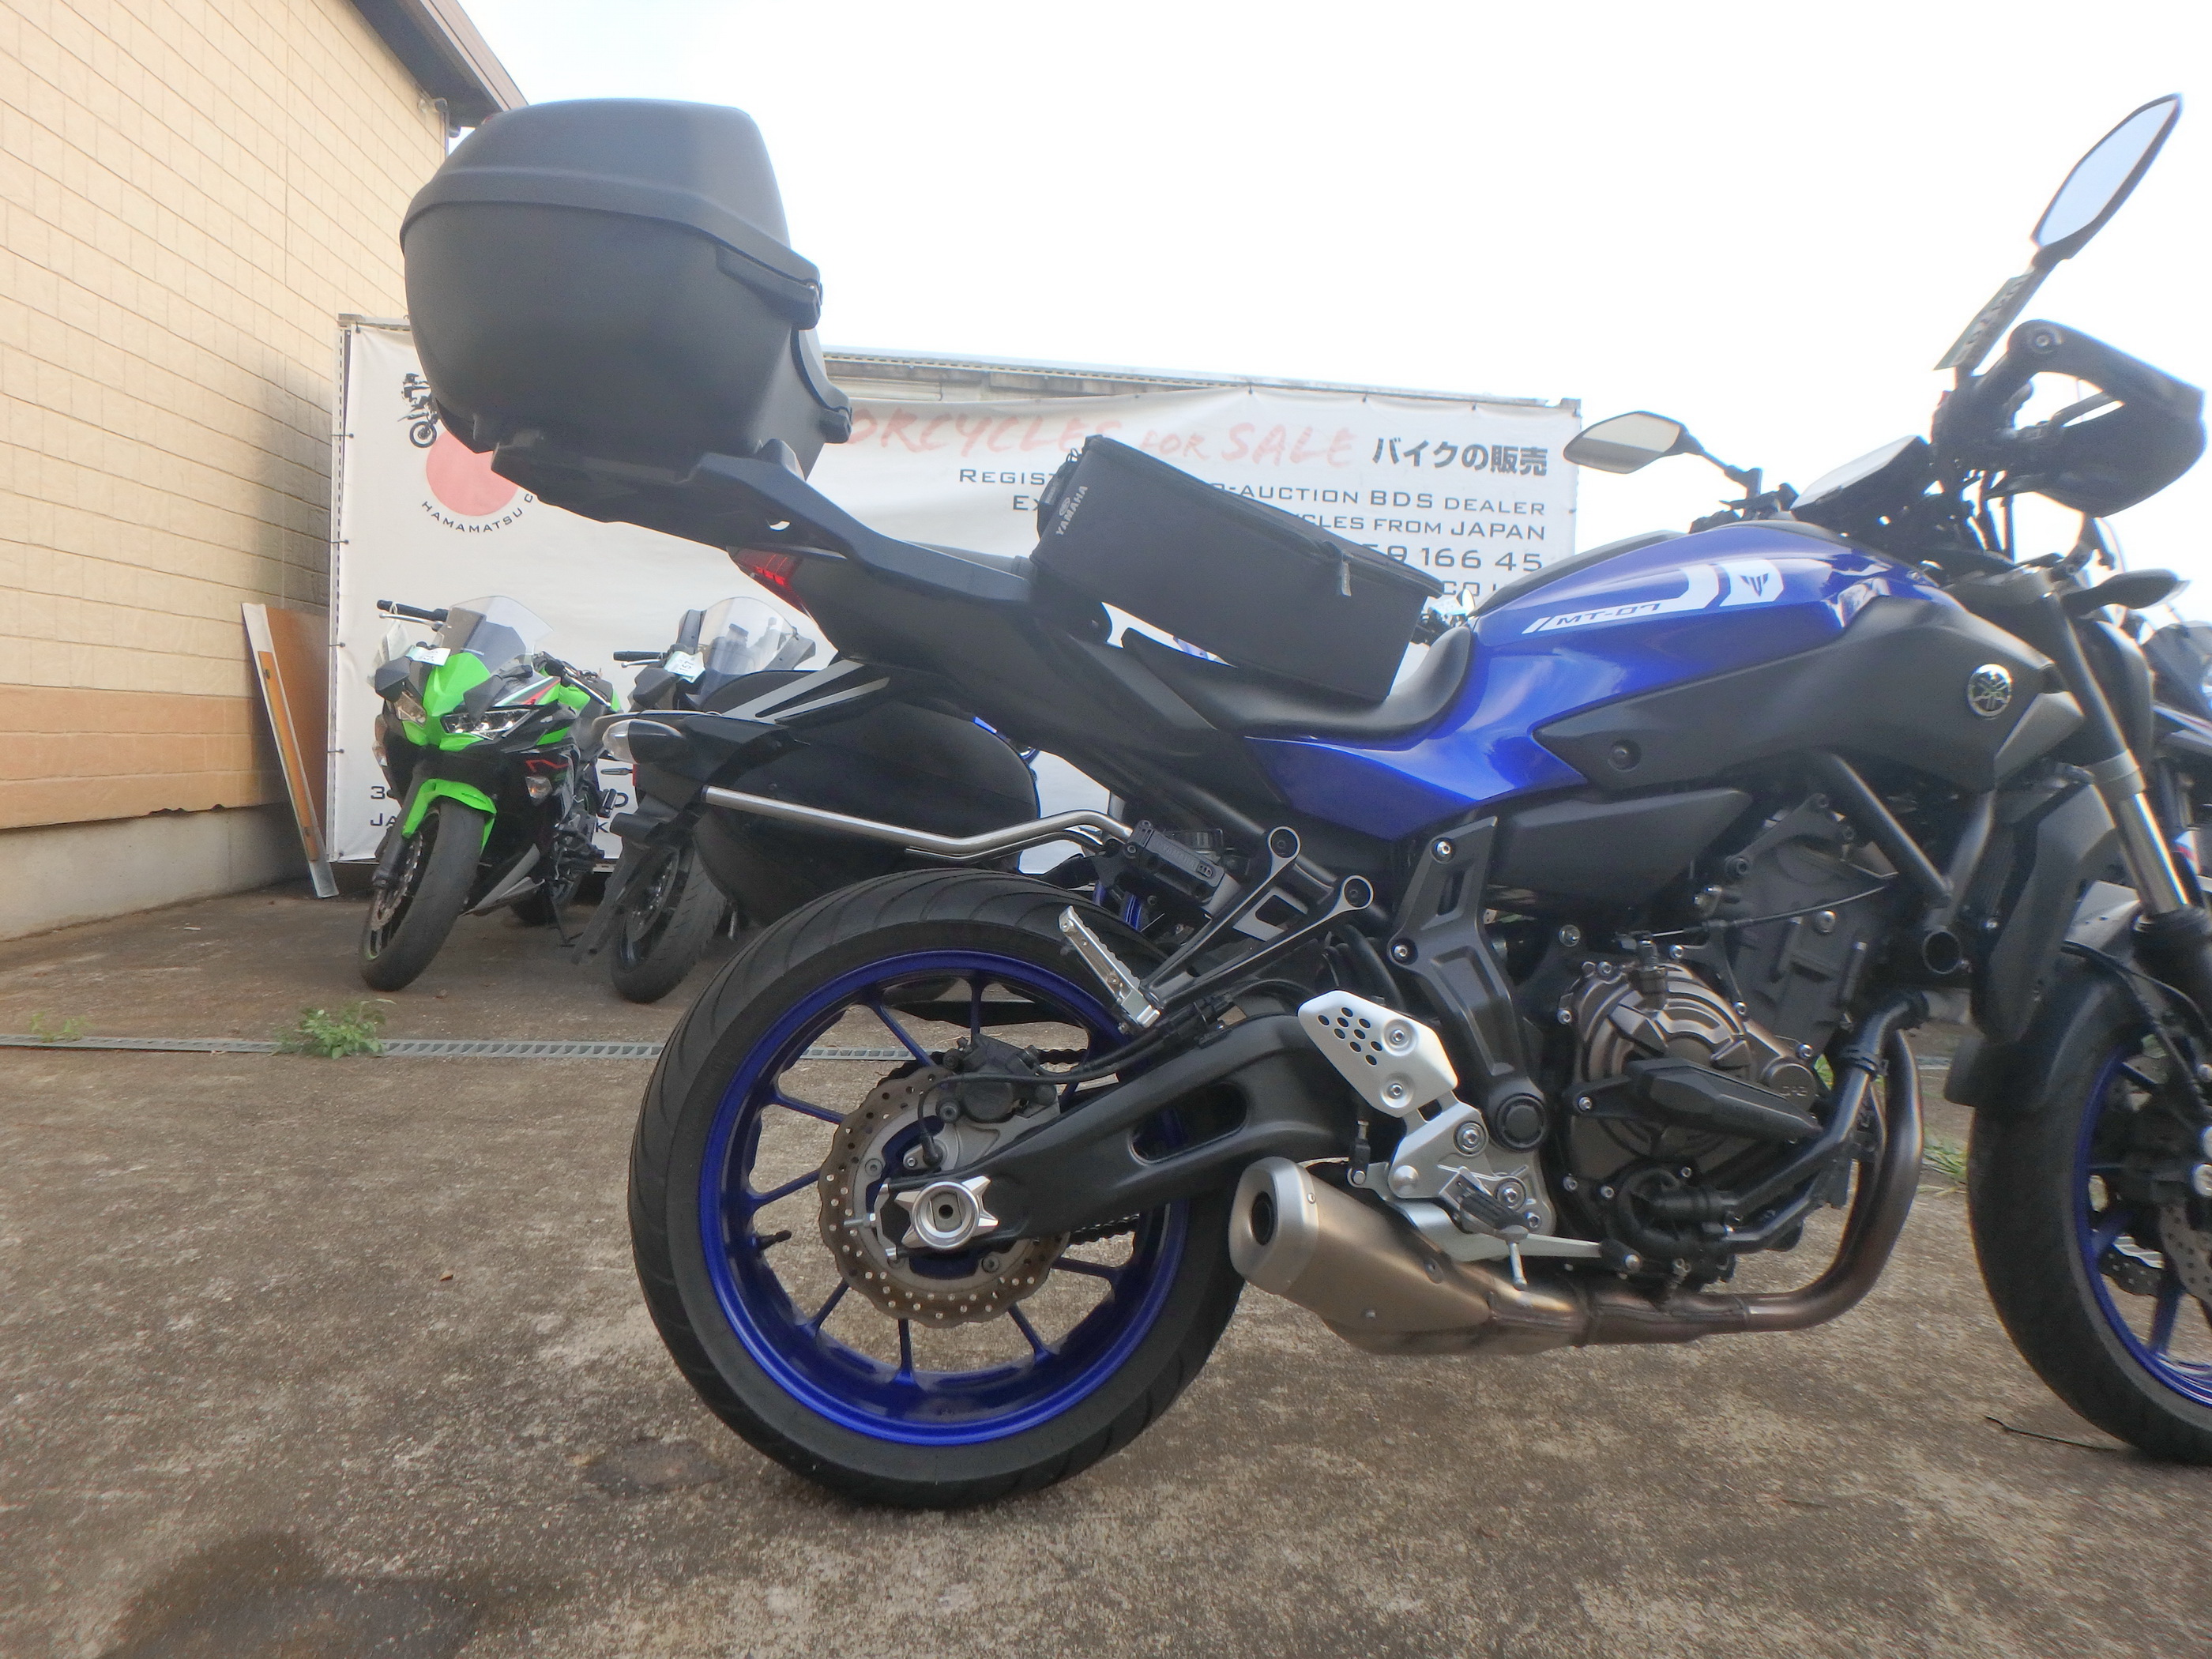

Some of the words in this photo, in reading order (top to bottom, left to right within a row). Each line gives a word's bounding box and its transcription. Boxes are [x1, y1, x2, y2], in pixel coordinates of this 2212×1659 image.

[1139, 429, 1210, 461] FOR
[1221, 422, 1355, 468] SALE
[1372, 437, 1548, 476] バイクの販売
[421, 501, 524, 533] HAMAMATSU
[1055, 486, 1089, 536] YAMAHA
[1370, 490, 1434, 509] BDS
[1444, 497, 1545, 516] DEALER
[1373, 518, 1442, 535] FROM
[1450, 521, 1545, 540] JAPAN
[1421, 547, 1482, 570] 166
[1494, 552, 1543, 573] 45
[1556, 603, 1661, 626] MT-07
